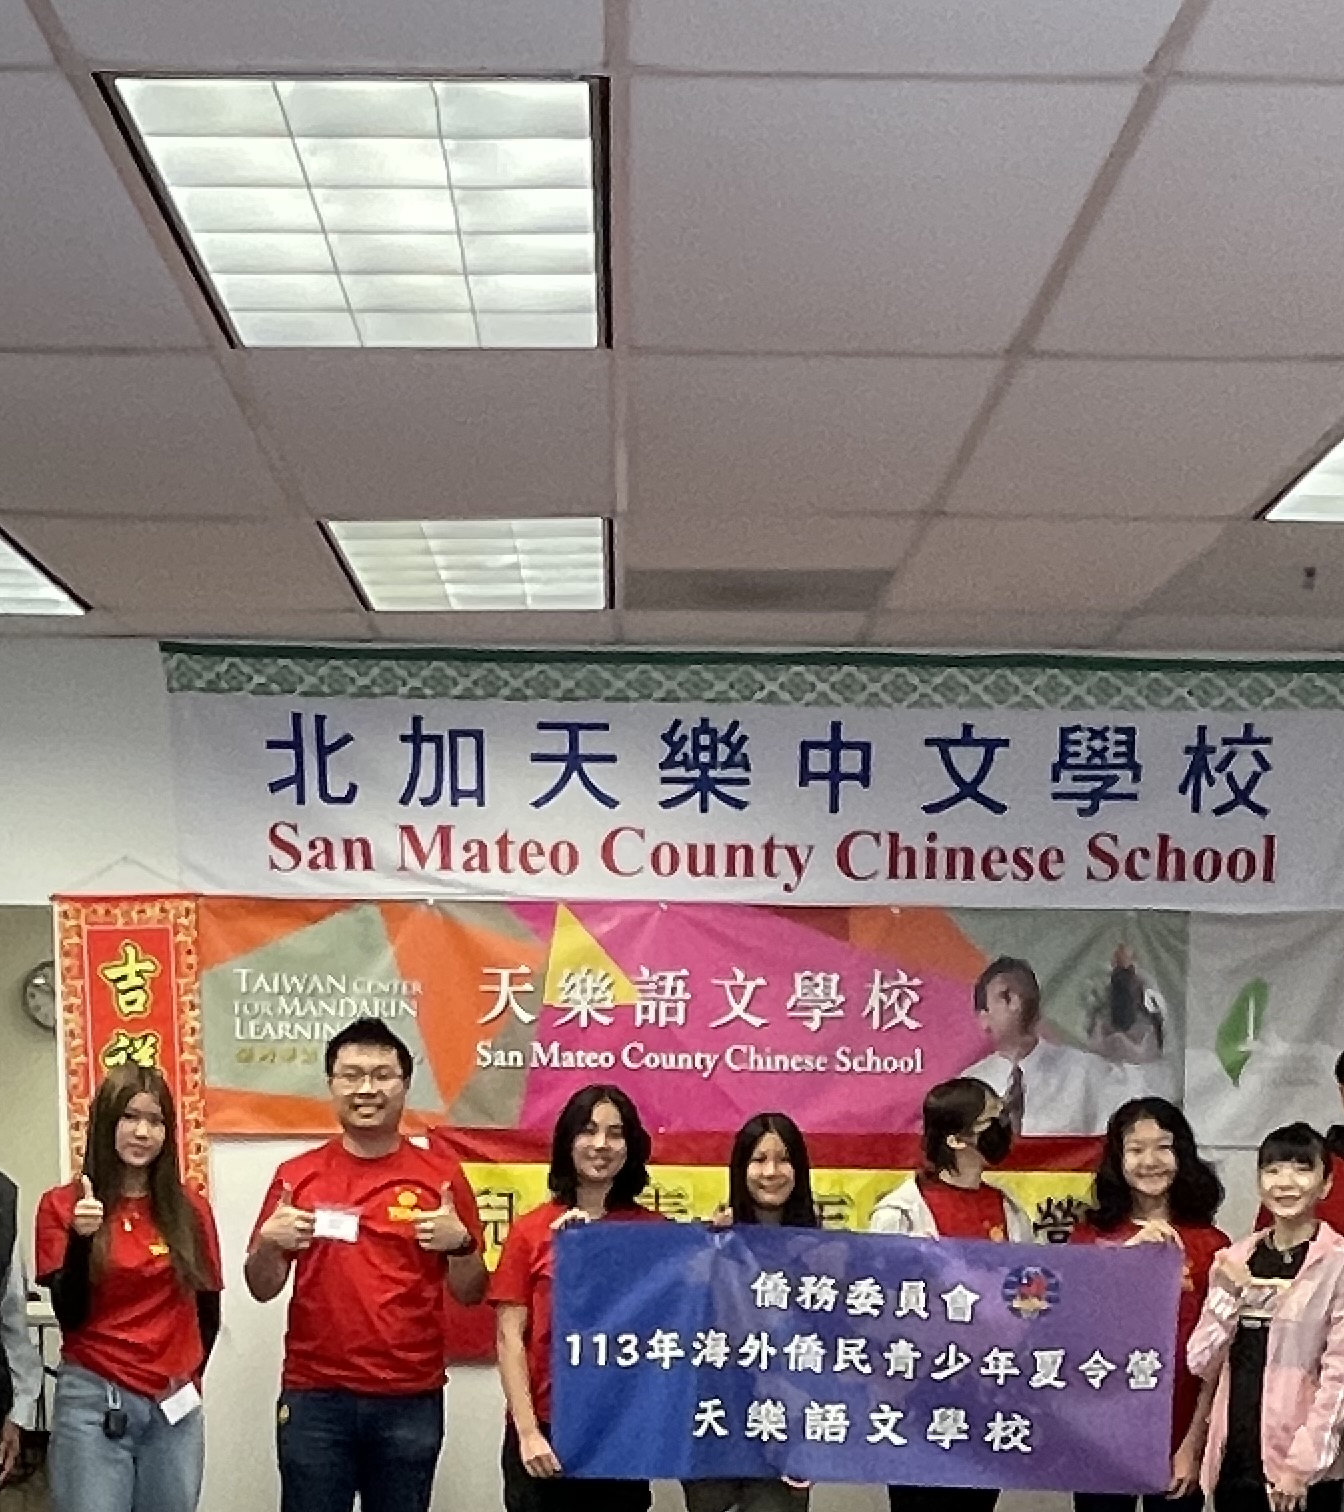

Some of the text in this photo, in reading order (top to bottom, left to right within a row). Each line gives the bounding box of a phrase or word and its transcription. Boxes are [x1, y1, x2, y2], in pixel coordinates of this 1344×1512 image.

[264, 711, 1274, 819] 北加天樂中文學校
[267, 821, 1277, 893] San Mateo County Chinese School
[233, 968, 346, 995] TAIWAN
[278, 997, 418, 1018] MANDARIN
[477, 964, 924, 1032] 天樂語文學校
[234, 1018, 351, 1041] LEARNIN
[476, 1040, 924, 1078] San Mateo County Chinese School
[750, 1269, 981, 1324] 僑務委員會
[564, 1327, 1164, 1392] 113年海外僑民青少年夏令營
[692, 1397, 1034, 1454] 天樂語文學校
